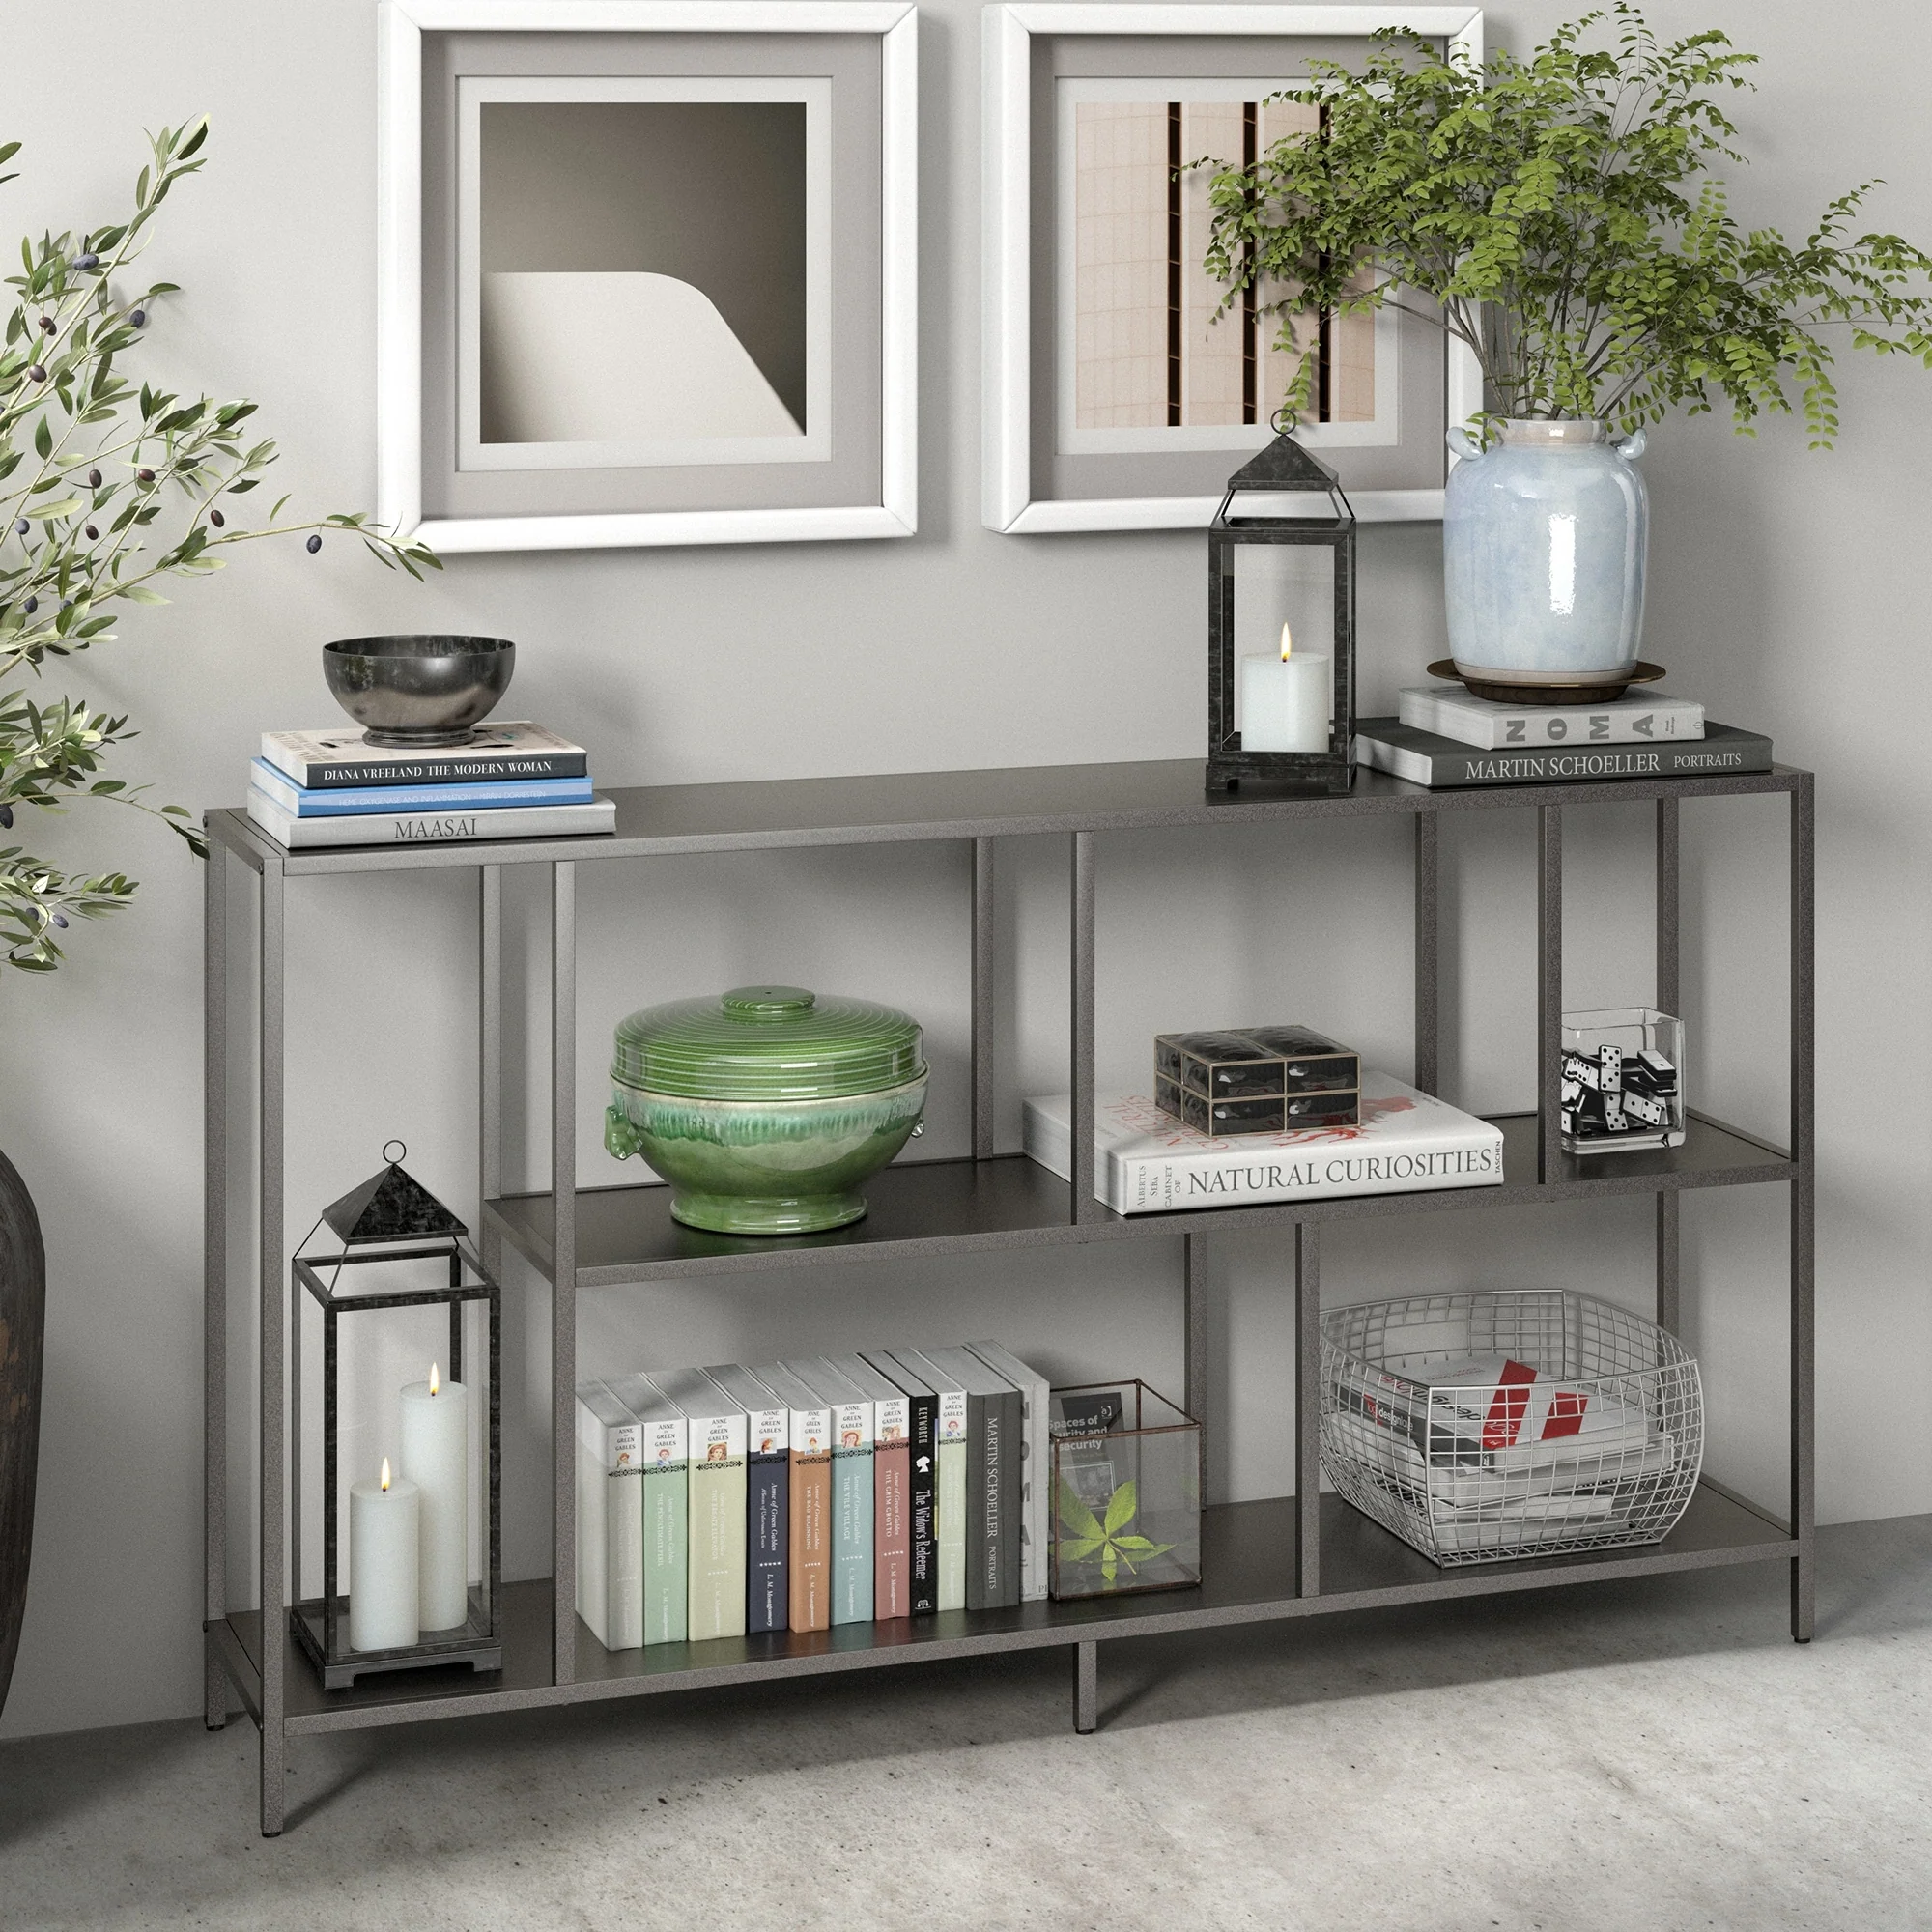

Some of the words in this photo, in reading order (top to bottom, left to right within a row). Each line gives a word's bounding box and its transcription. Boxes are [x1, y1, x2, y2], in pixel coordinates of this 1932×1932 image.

[324, 769, 359, 781] DIANA
[363, 766, 423, 779] VREELAND
[426, 765, 451, 777] THE
[454, 762, 504, 775] MODERN
[508, 760, 552, 773] WOMAN
[1465, 758, 1545, 779] MARTIN
[1548, 753, 1661, 777] SCHOELLER
[1673, 753, 1742, 768] PORTRAITS
[402, 795, 419, 804] AND
[394, 818, 477, 839] MAASAI
[1188, 1163, 1320, 1194] NATURAL
[1326, 1148, 1492, 1182] CURIOSITIES
[1137, 1165, 1146, 1208] ALBERTUS
[1150, 1176, 1158, 1197] SEBA
[1175, 1180, 1180, 1194] OF
[918, 1406, 928, 1444] KEYWORTH
[1087, 1414, 1098, 1427] of
[987, 1417, 999, 1465] MARTIN
[916, 1490, 931, 1506] The
[987, 1468, 999, 1538] SCHOELLER
[915, 1506, 931, 1539] Widow's
[915, 1540, 931, 1580] Redeemer
[988, 1546, 997, 1590] PORTRAITS
